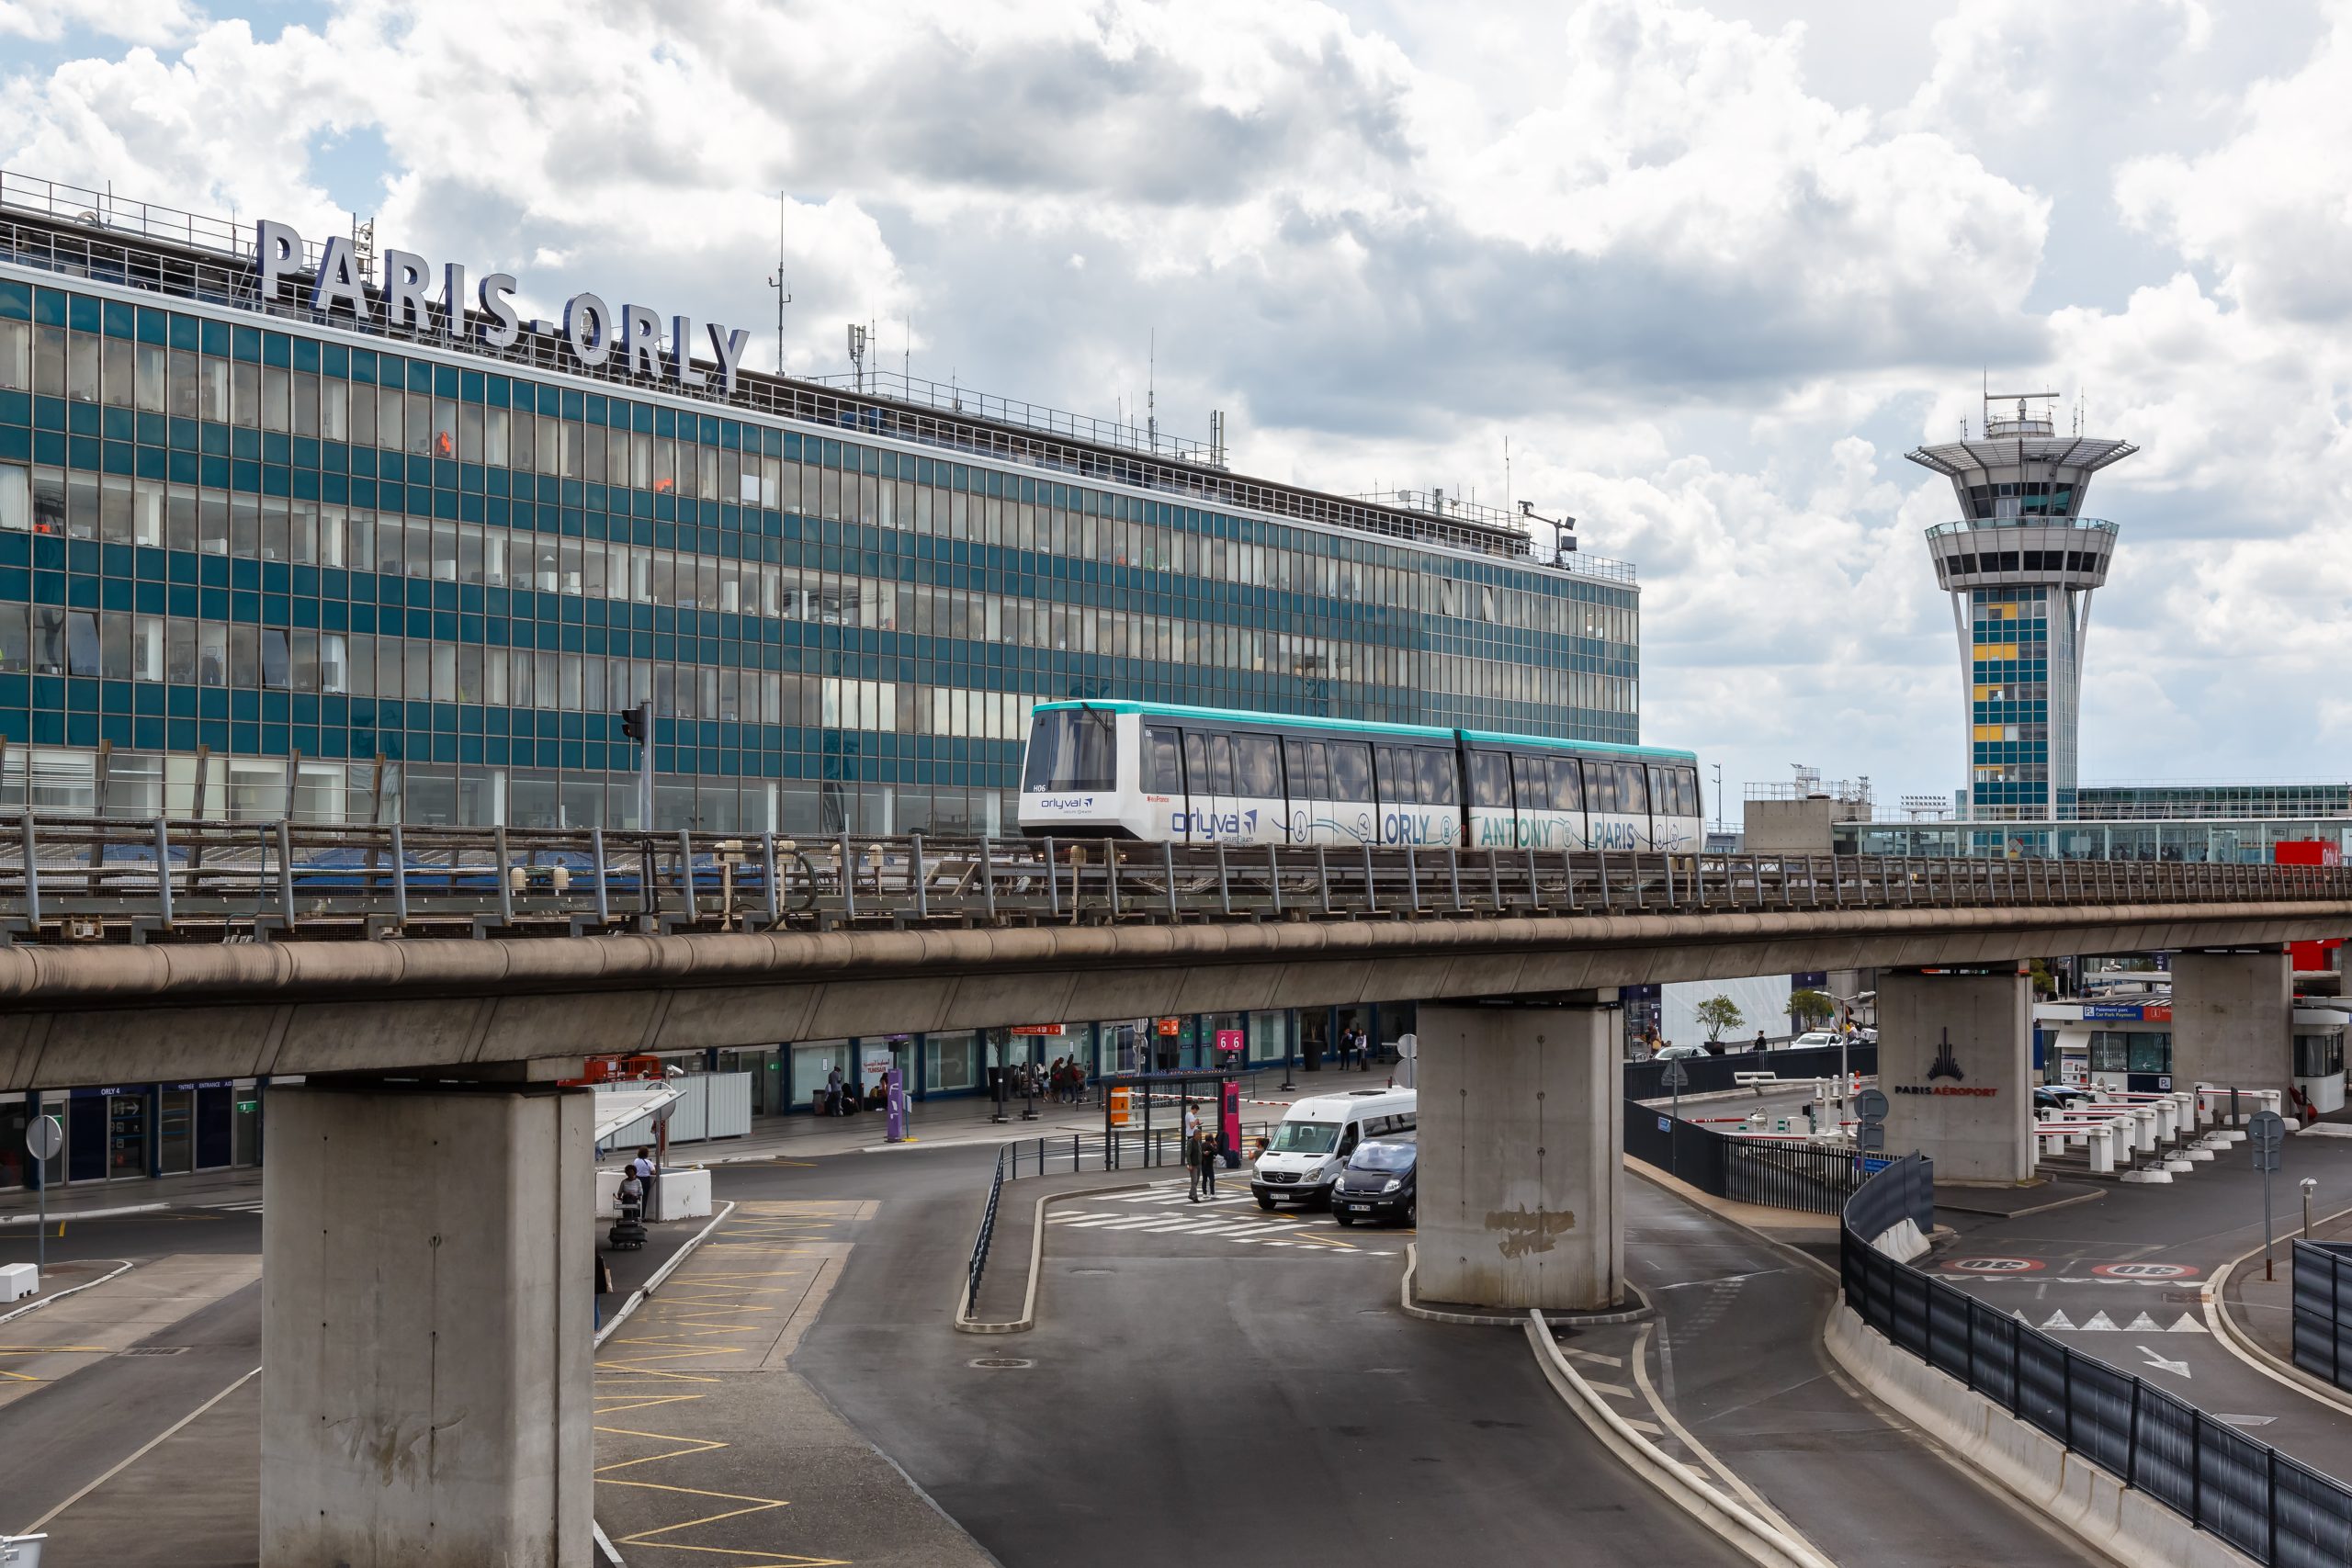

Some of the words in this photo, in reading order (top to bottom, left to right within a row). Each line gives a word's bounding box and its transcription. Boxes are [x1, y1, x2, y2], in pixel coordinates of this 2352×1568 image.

[1033, 784, 1046, 793] H06
[1041, 797, 1081, 809] orlyval
[1385, 814, 1430, 845] ORLY
[1481, 817, 1552, 847] ANTONY
[1594, 821, 1634, 850] PARIS
[1220, 1037, 1227, 1047] 6
[1233, 1037, 1239, 1047] 6
